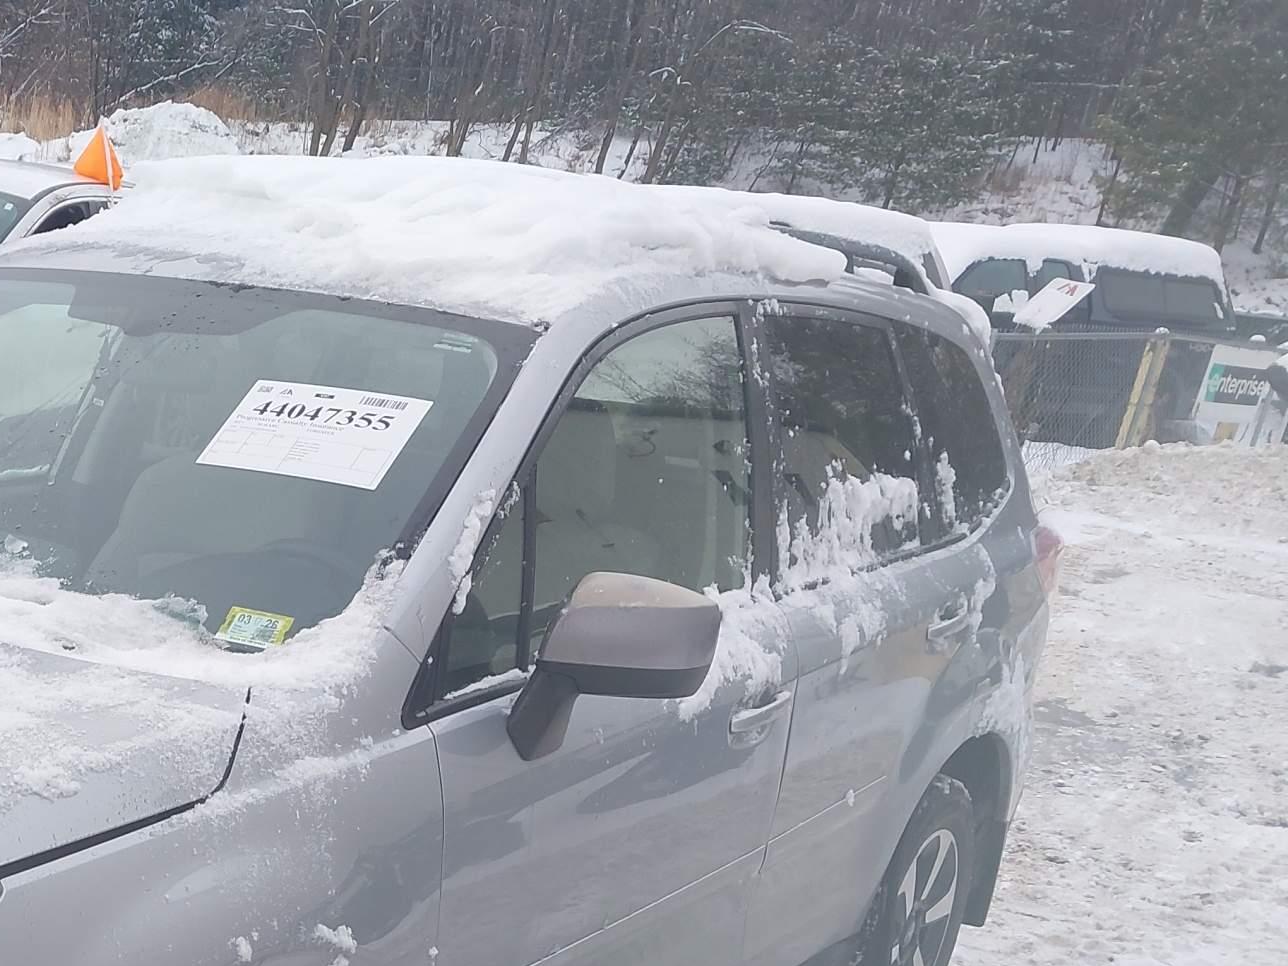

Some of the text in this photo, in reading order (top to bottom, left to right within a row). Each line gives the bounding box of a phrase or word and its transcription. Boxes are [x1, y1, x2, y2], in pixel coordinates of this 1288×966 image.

[1206, 374, 1265, 400] enterprise
[253, 401, 395, 431] 44047355
[238, 614, 252, 625] 03
[265, 619, 280, 630] 26
